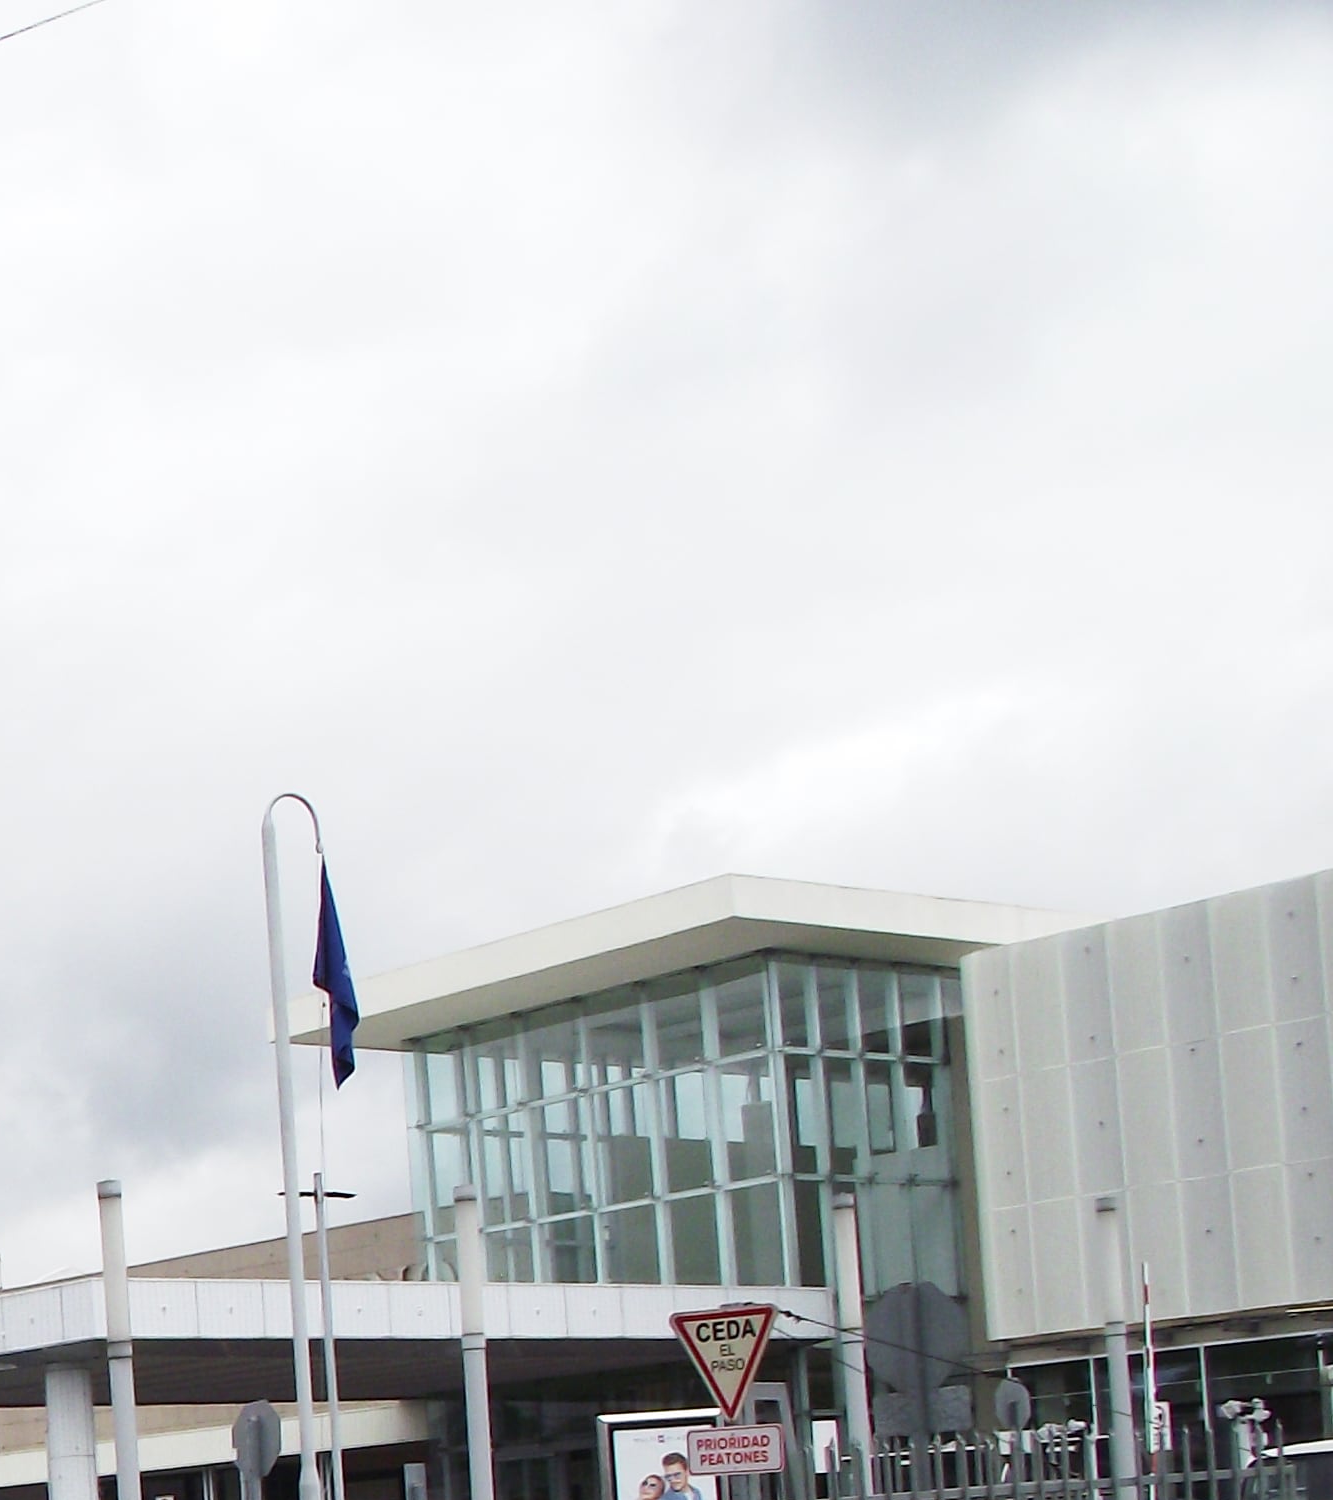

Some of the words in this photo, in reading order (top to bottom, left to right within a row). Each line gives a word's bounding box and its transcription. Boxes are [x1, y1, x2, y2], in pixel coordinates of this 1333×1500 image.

[696, 1319, 757, 1343] CEDA
[719, 1344, 736, 1357] EL
[710, 1358, 746, 1372] PASO
[696, 1434, 771, 1451] PRIORIDAD
[700, 1450, 769, 1467] PEATONES
